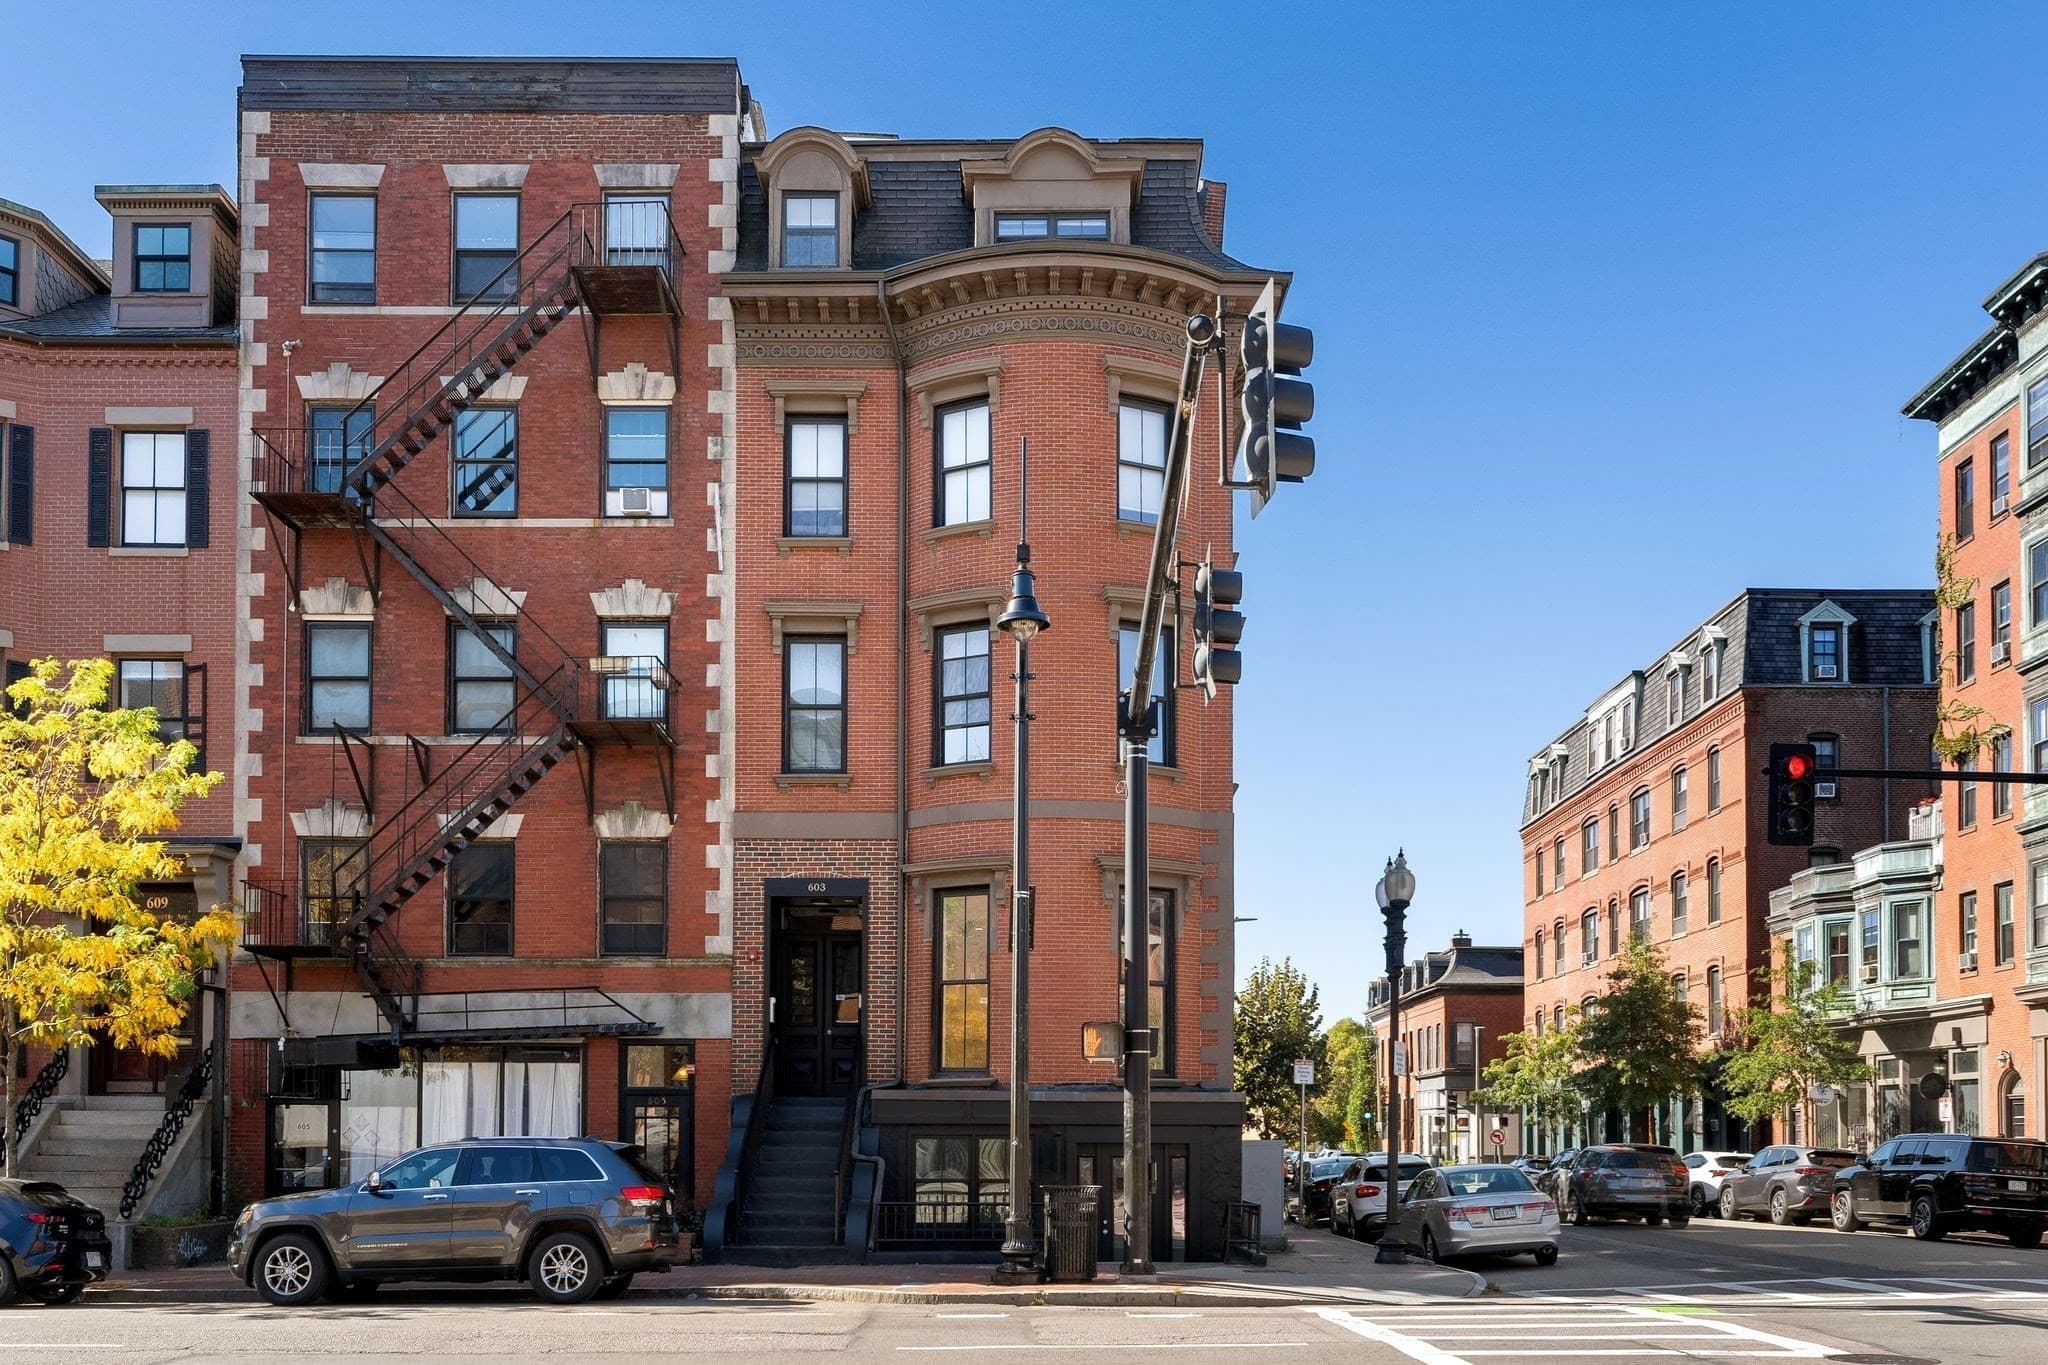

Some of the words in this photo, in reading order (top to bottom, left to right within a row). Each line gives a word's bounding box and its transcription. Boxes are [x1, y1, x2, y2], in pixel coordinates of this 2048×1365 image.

[807, 882, 826, 892] 603
[146, 896, 169, 909] 609
[647, 1096, 667, 1105] 605
